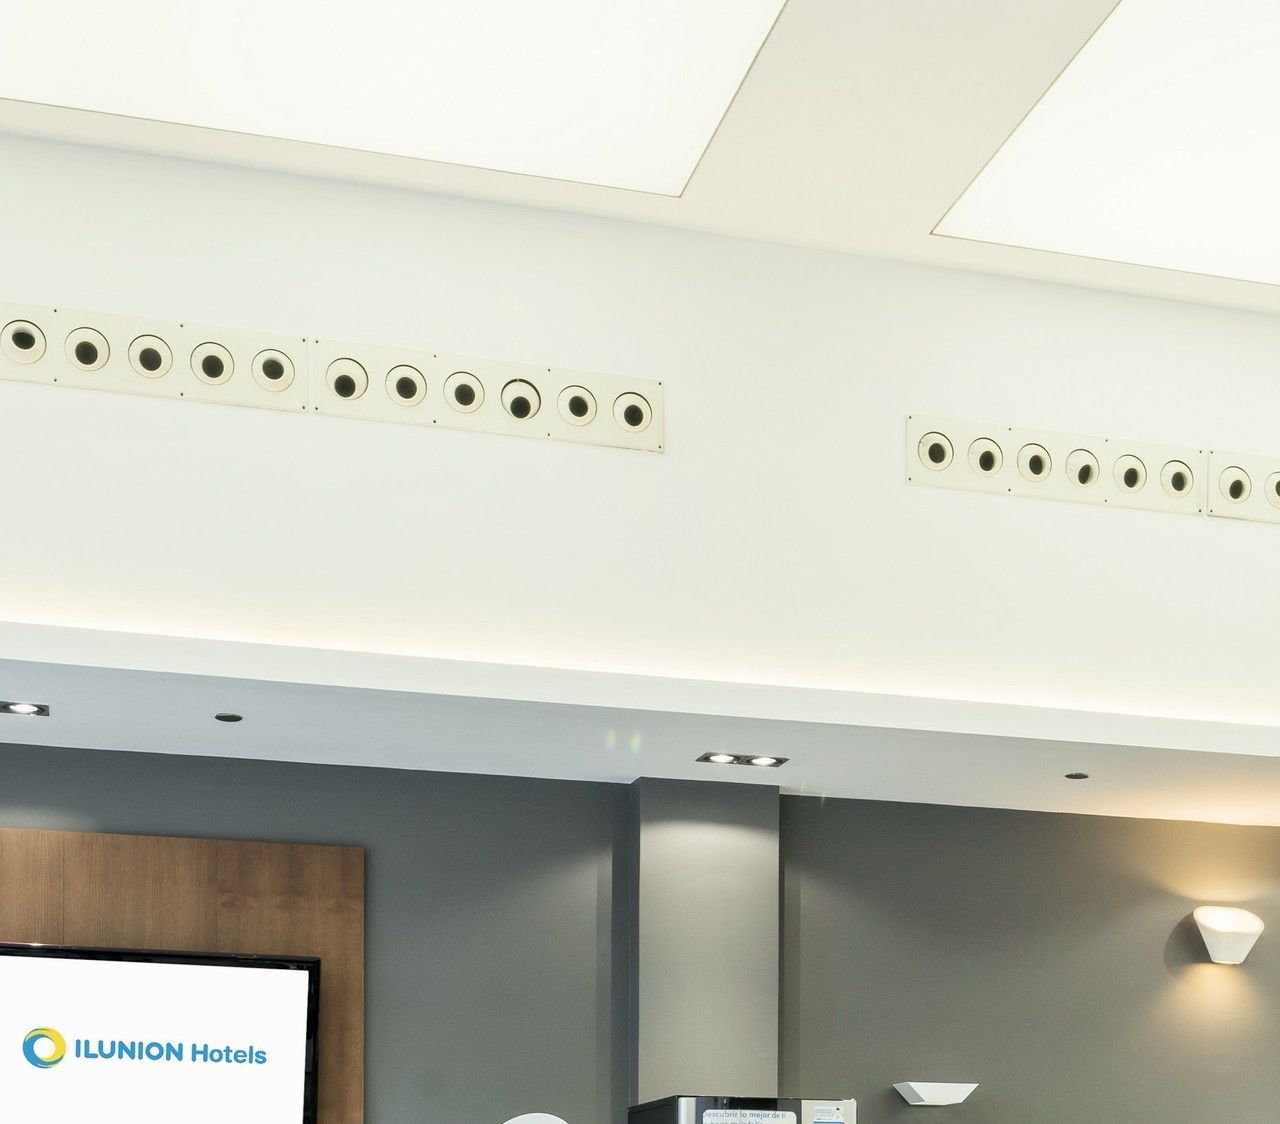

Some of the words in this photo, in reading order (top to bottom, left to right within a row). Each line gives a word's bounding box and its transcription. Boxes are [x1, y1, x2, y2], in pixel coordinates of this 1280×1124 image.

[75, 1039, 183, 1062] ILUNION
[191, 1043, 267, 1065] Hotels
[749, 1111, 770, 1120] mejor
[771, 1111, 780, 1119] de
